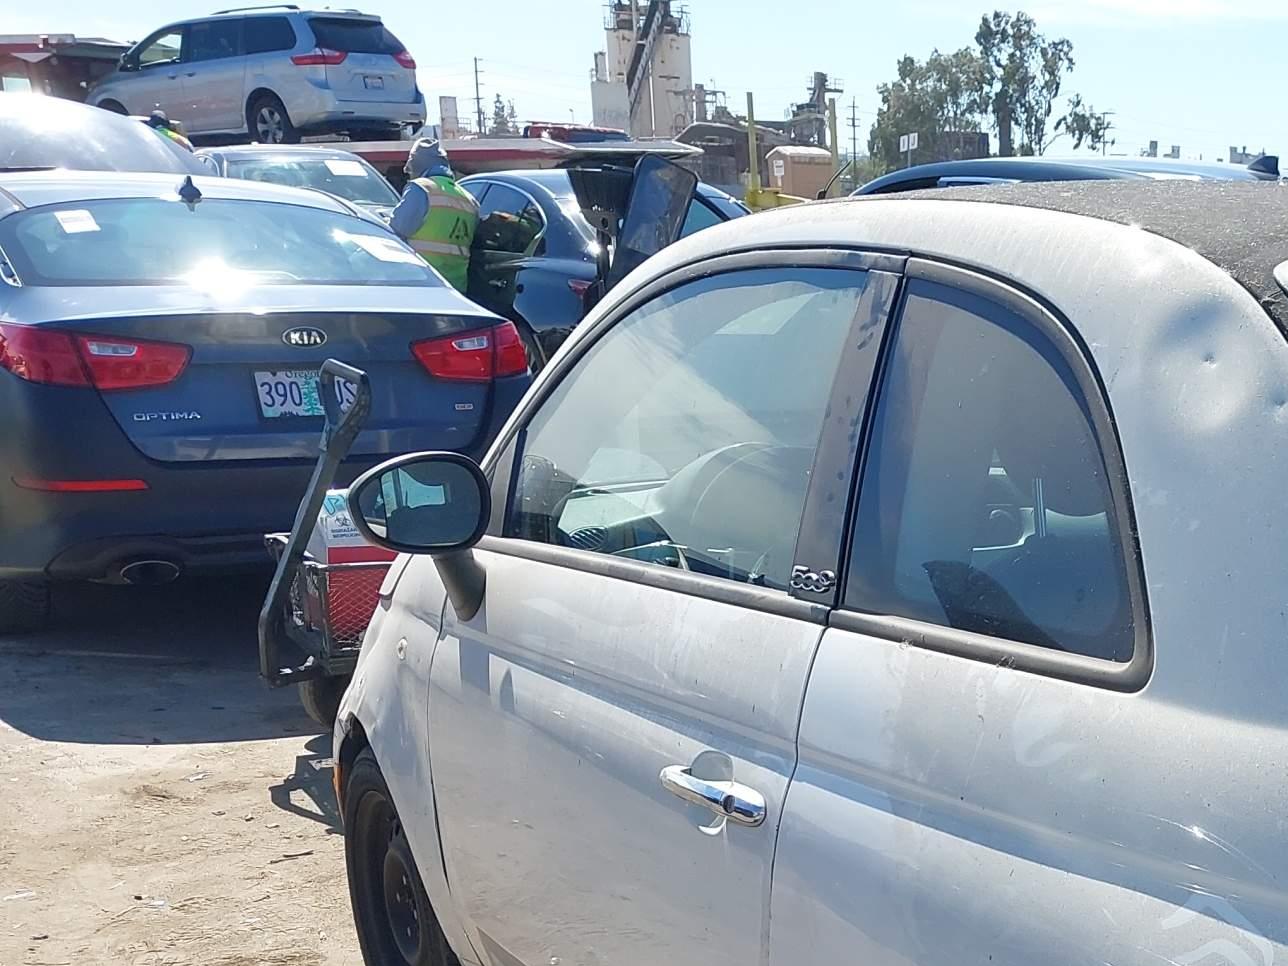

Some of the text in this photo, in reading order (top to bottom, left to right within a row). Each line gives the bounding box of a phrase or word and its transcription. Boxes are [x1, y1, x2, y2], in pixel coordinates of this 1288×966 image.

[290, 331, 322, 345] KIA
[260, 381, 303, 408] 390
[133, 411, 201, 421] OPTIMA
